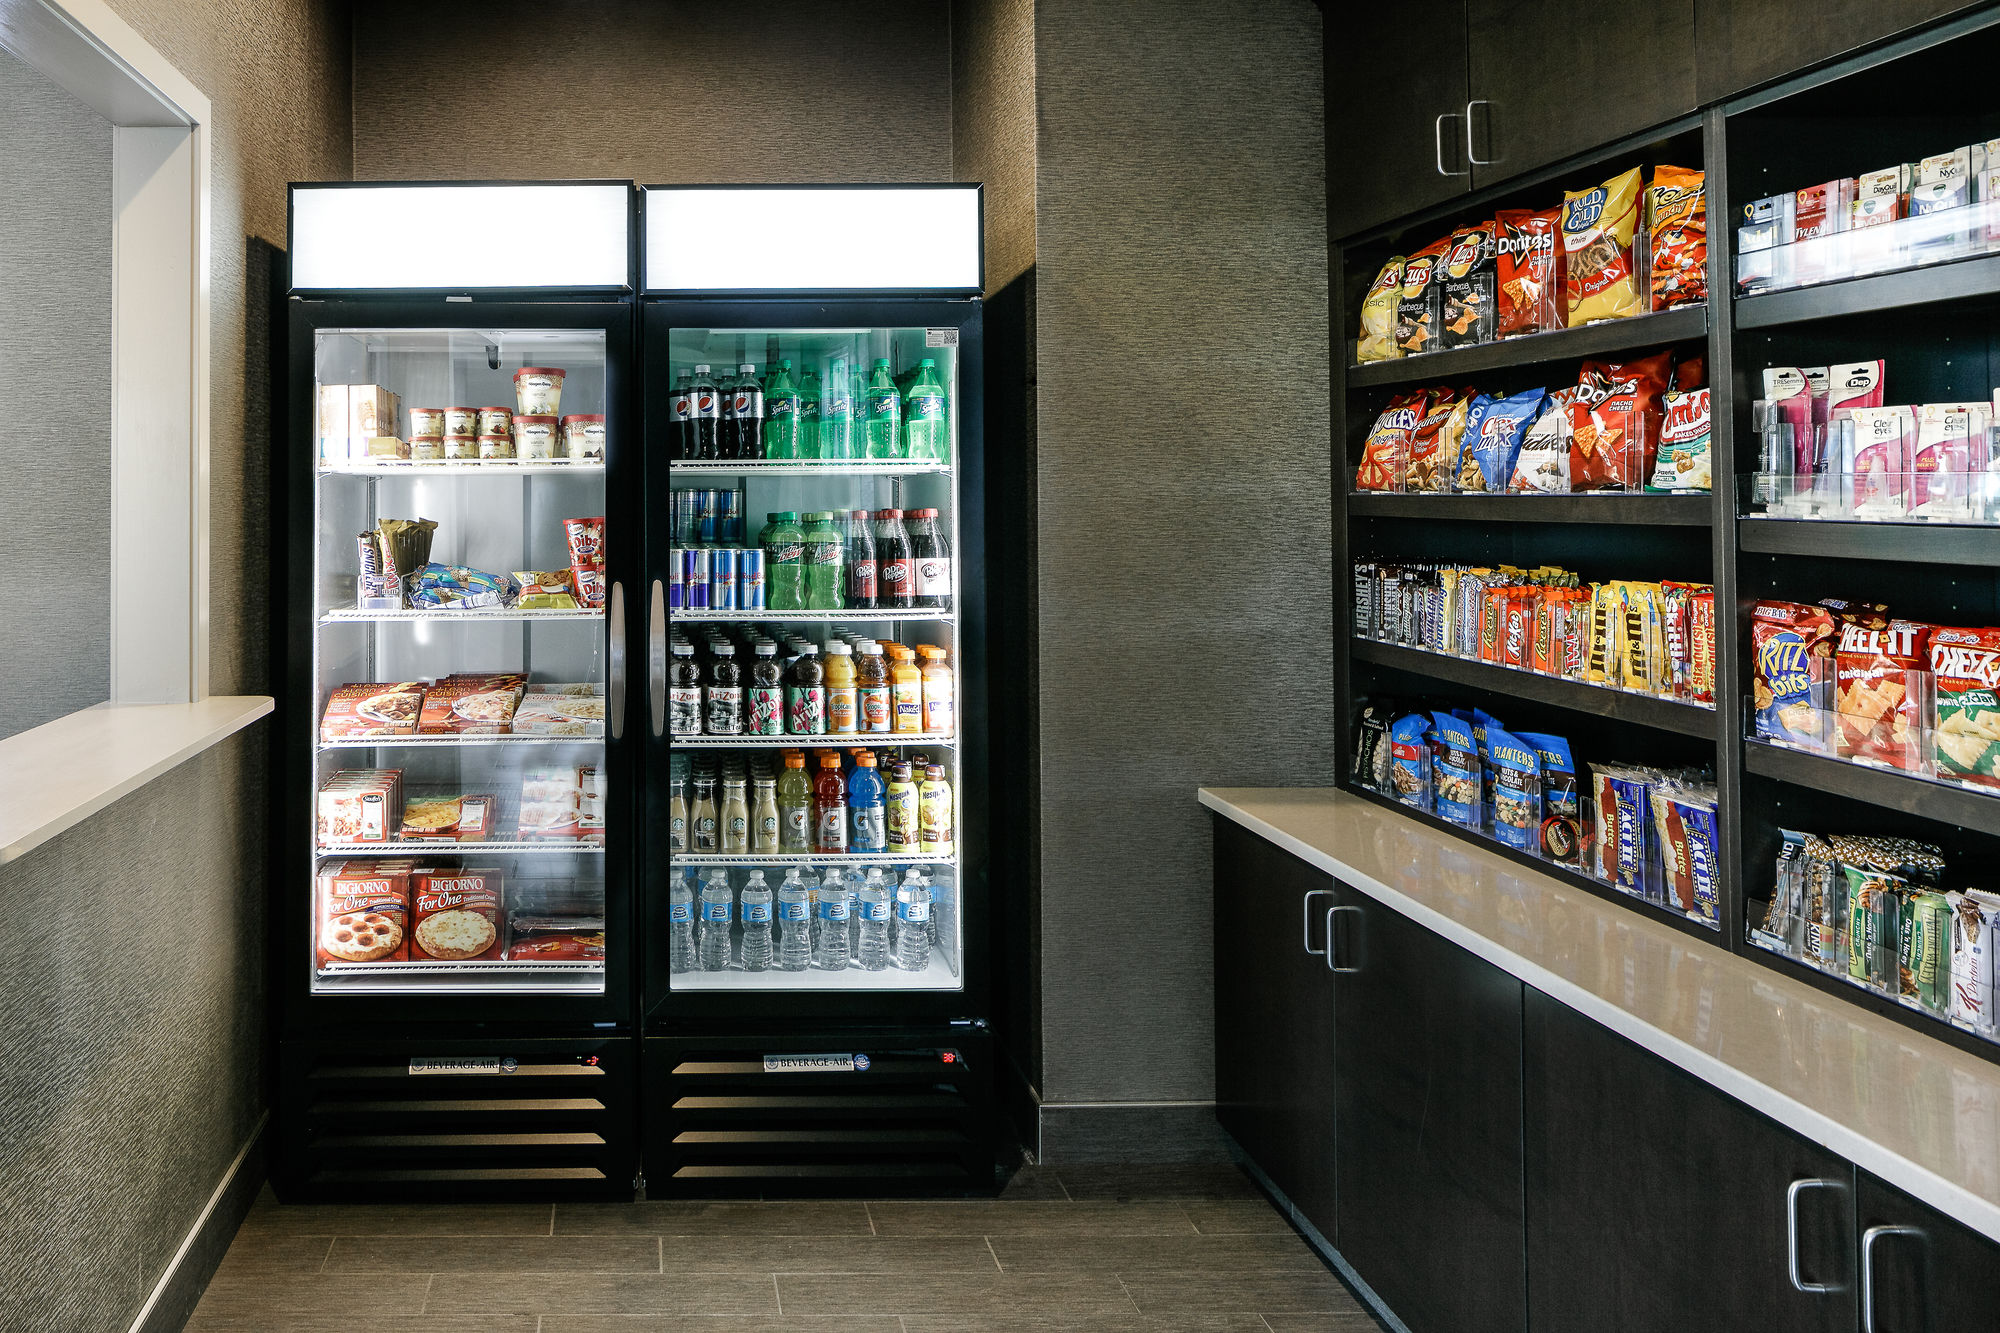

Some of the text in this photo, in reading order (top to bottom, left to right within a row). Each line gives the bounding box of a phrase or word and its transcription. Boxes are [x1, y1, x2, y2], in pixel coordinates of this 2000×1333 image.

[1498, 232, 1552, 255] Doritos
[1445, 281, 1470, 293] Barbecue
[1584, 274, 1610, 292] Original
[1398, 303, 1424, 312] Barbecue
[1850, 377, 1870, 388] Dep
[771, 402, 791, 416] Sprite
[828, 402, 848, 415] Sprite
[1674, 429, 1694, 439] BAKED
[574, 534, 598, 548] Dibs
[693, 572, 707, 580] Bull
[743, 572, 756, 580] Red
[884, 567, 908, 580] Pepper
[1354, 563, 1370, 629] HERSHEY'S
[1437, 573, 1448, 651] Butterfinger
[1755, 606, 1788, 620] BIG BAG
[1481, 601, 1494, 649] Reese's
[1535, 609, 1548, 661] Reese's
[1937, 632, 1960, 642] Grab
[1966, 635, 1980, 644] Go
[1760, 637, 1807, 677] RITZ
[1770, 673, 1809, 699] bits
[899, 705, 920, 714] Naked
[1472, 726, 1488, 742] PLANT
[1362, 729, 1374, 779] PISTACHIOS
[1494, 746, 1535, 768] PLANTERS
[1534, 749, 1564, 767] TERS
[889, 790, 910, 802] Nesquik
[922, 787, 946, 800] Nesqk
[1606, 813, 1615, 850] Butter
[1621, 809, 1634, 844] ACT
[1674, 839, 1687, 878] Butter
[1691, 837, 1708, 874] ACT
[344, 895, 368, 911] One
[416, 891, 462, 913] For One
[1905, 918, 1913, 935] Oats
[1809, 921, 1821, 958] KIND
[1865, 945, 1873, 962] Oats
[1900, 943, 1911, 966] Honey
[1966, 957, 1978, 995] Protein
[780, 1057, 851, 1067] BEVERAGE-AIR
